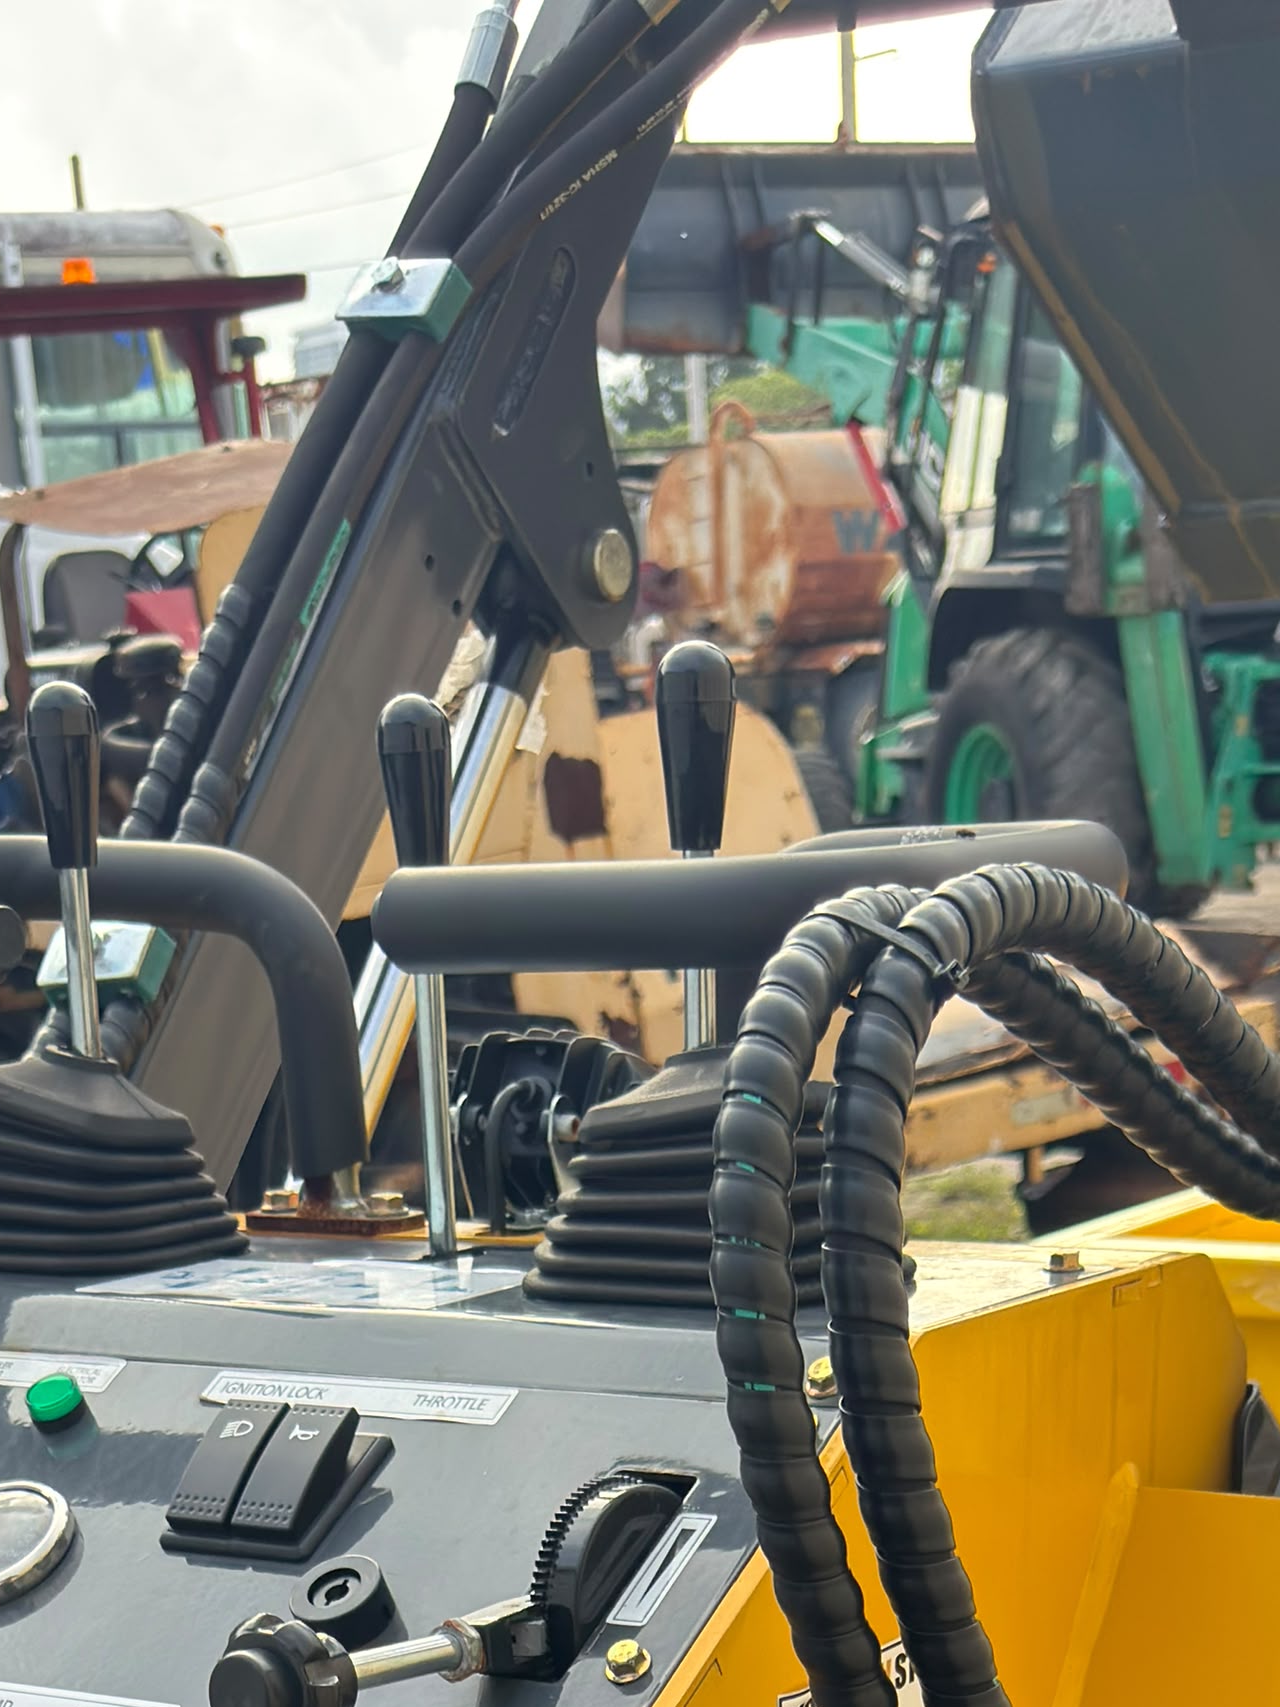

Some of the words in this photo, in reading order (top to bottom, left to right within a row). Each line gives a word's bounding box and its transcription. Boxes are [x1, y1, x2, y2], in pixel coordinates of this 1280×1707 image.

[220, 1380, 288, 1398] IGNITION
[289, 1384, 329, 1401] LOCK
[411, 1393, 491, 1412] THROTTLE
